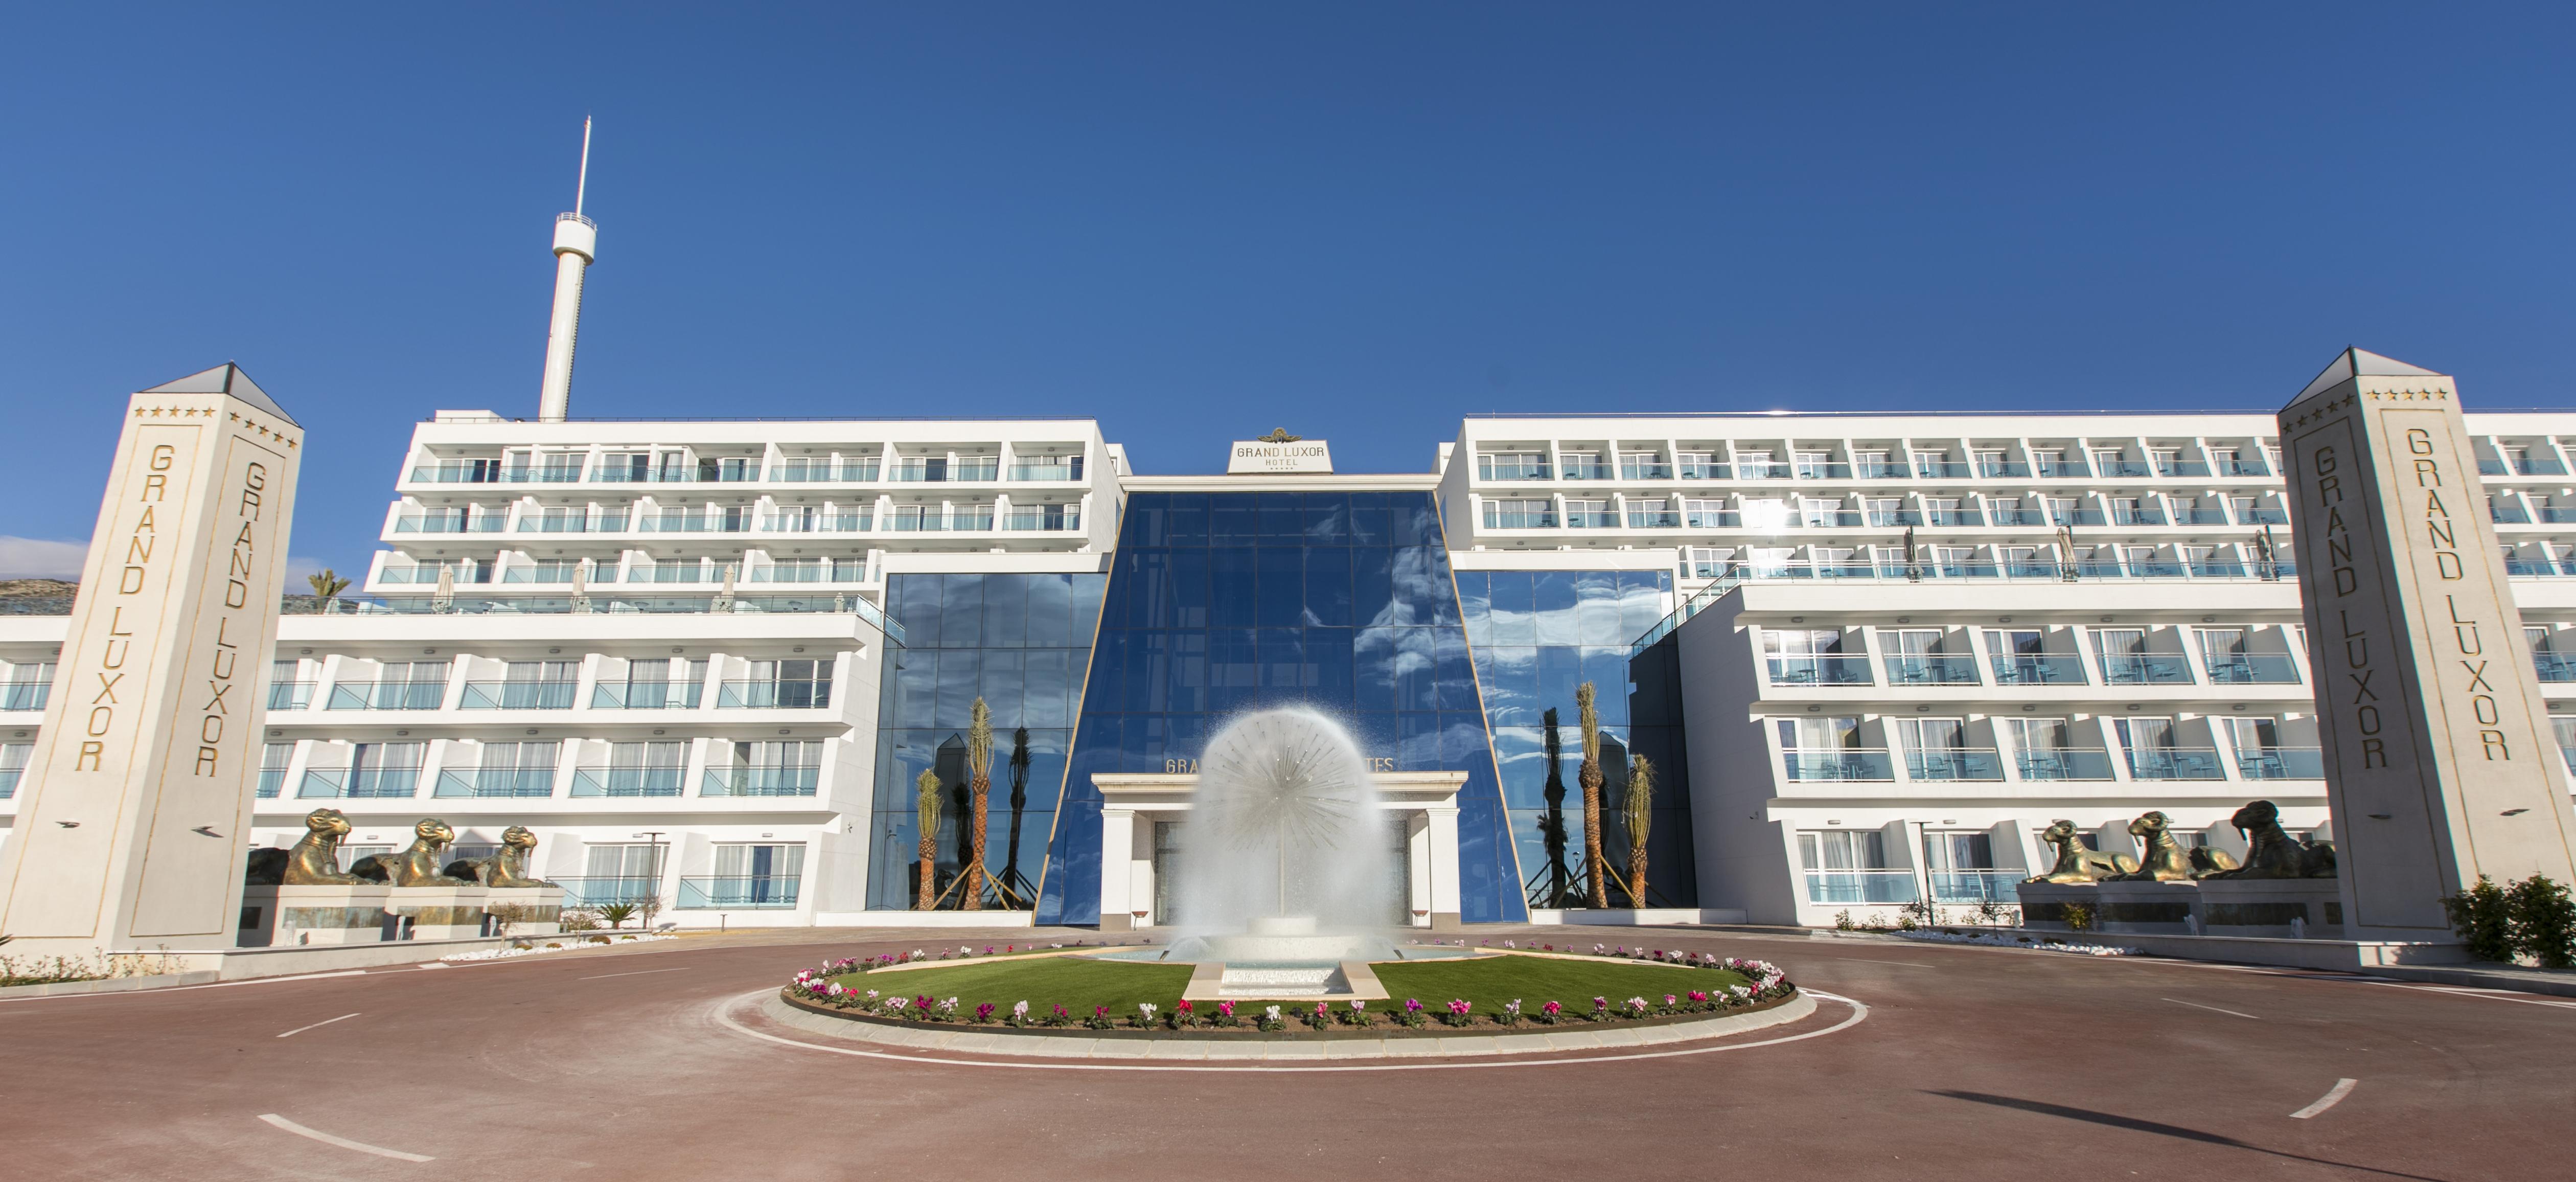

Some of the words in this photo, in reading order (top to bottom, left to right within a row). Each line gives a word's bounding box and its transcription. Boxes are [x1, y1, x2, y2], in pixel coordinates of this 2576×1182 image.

[119, 444, 175, 595] GRAND
[1237, 448, 1279, 457] GRAND
[1284, 447, 1324, 457] LUXOR
[224, 462, 266, 609] GRAND
[2315, 446, 2357, 598] GRAND
[2340, 609, 2387, 769] LUXOR
[2406, 428, 2463, 581] GRAND
[2446, 595, 2510, 761] LUXOR
[75, 607, 132, 771] LUXOR
[194, 617, 237, 777] LUXOR
[1166, 759, 1200, 774] GRA
[1364, 757, 1393, 772] TES
